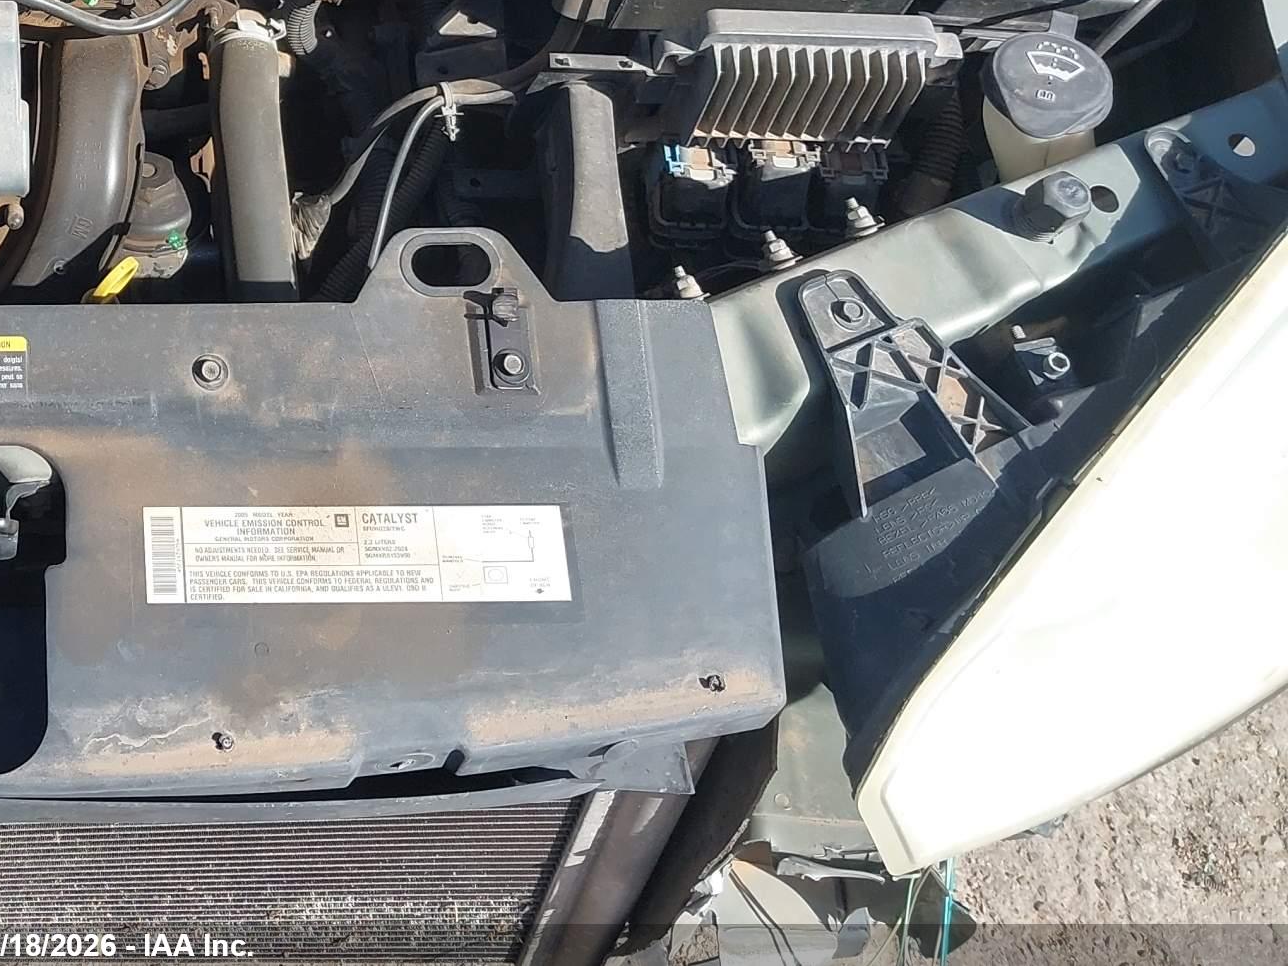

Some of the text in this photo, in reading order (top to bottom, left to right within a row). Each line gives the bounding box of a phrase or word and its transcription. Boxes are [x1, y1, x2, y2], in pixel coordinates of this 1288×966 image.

[362, 513, 418, 524] CATALYST
[204, 519, 324, 528] VEHICLE EMISSION CONTROL
[286, 546, 310, 554] SERVICE
[356, 569, 394, 577] APPLICABLE
[396, 569, 405, 577] TO
[406, 569, 421, 577] NEW
